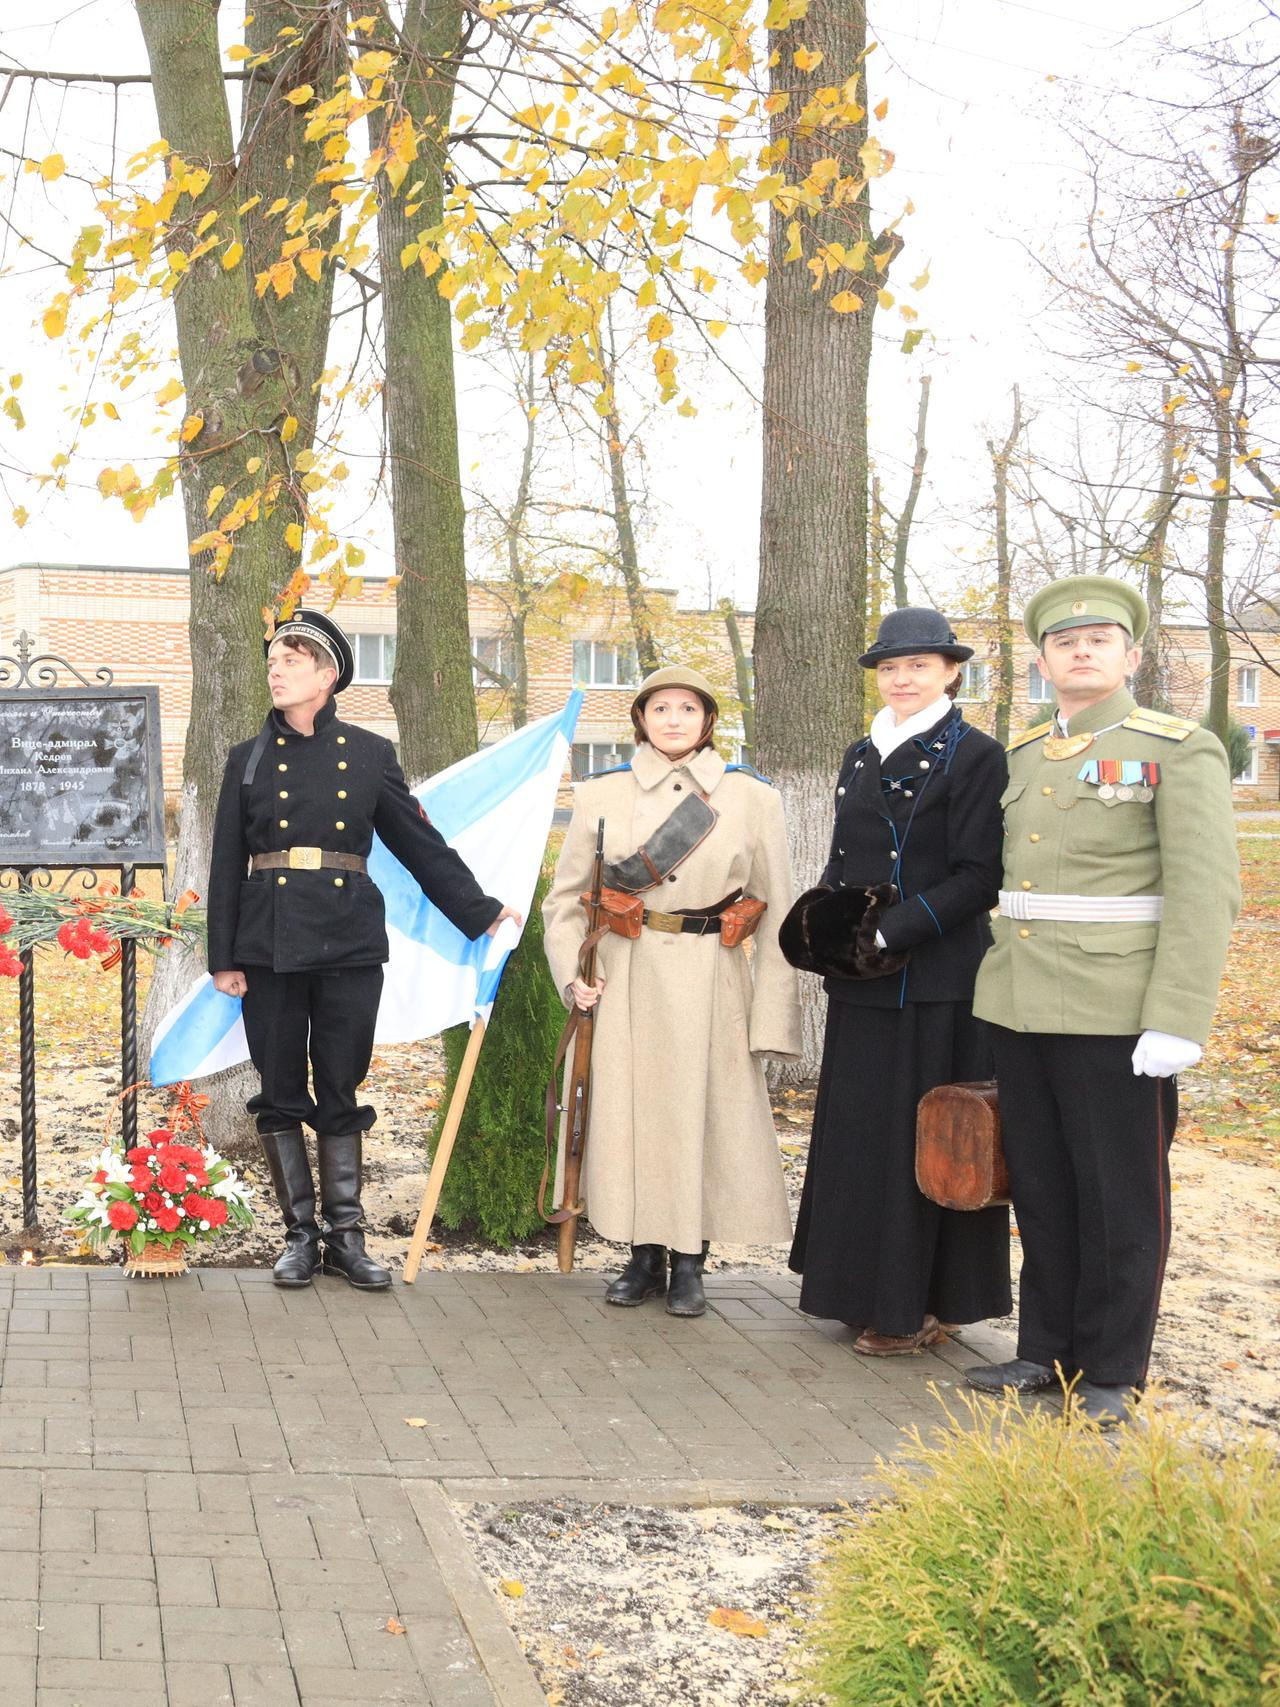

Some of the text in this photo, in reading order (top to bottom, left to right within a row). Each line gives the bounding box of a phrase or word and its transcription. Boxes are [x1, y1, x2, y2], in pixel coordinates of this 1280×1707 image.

[10, 737, 98, 751] Вице-адмирал
[34, 751, 72, 762] Кедров
[20, 781, 46, 792] 1878
[59, 781, 85, 792] 1945
